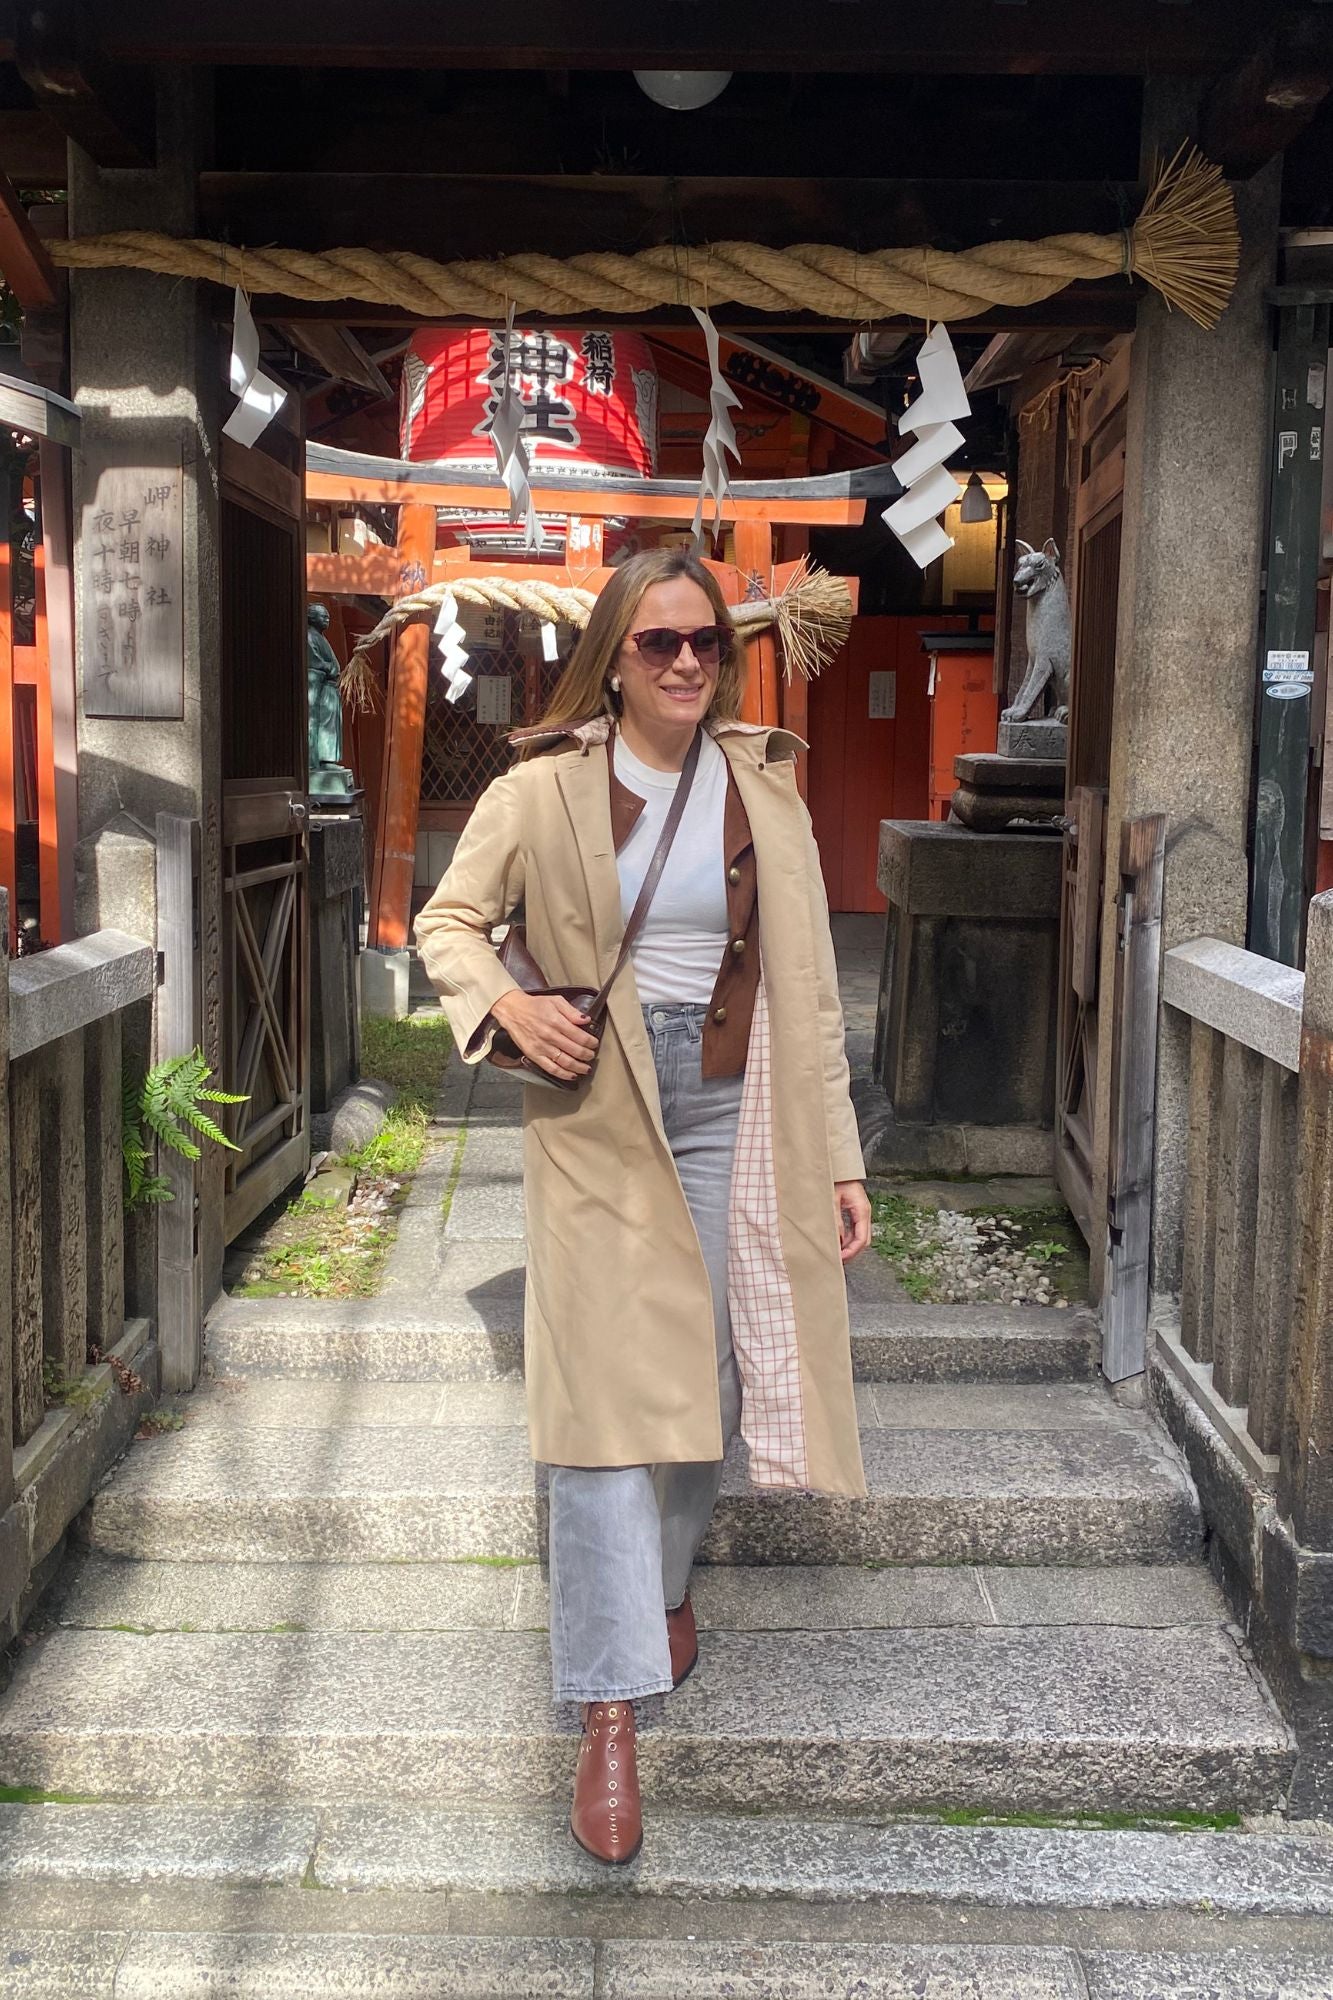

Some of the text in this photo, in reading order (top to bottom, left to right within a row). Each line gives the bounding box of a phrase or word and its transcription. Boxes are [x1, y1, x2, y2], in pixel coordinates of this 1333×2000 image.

[582, 331, 614, 395] 稲荷
[143, 485, 172, 607] 岬神社
